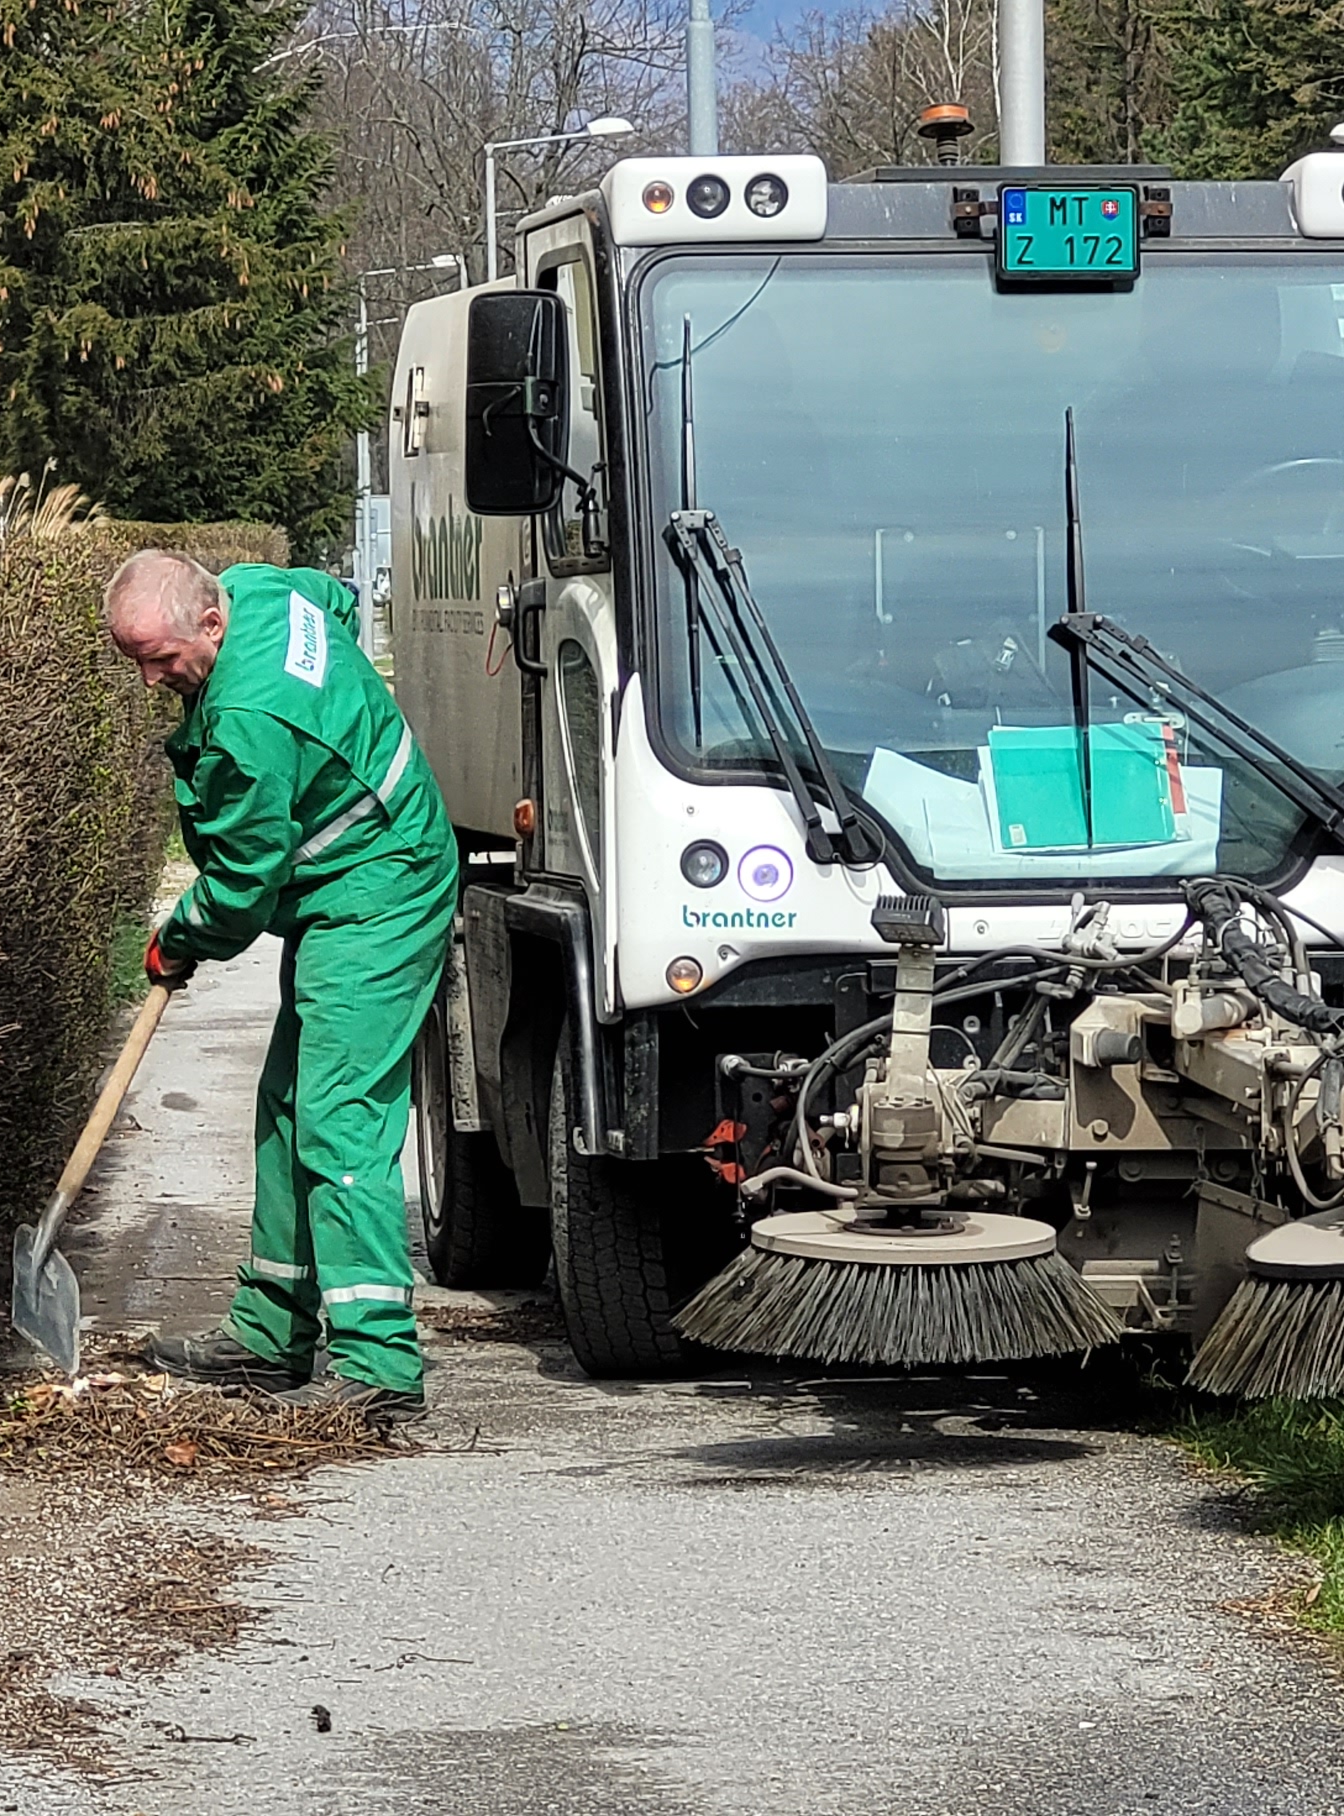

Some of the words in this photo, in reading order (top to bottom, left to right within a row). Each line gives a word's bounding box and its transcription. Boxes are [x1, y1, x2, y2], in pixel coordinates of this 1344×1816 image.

[1008, 212, 1023, 223] SK
[1049, 196, 1089, 226] MT
[1016, 235, 1034, 265] Z
[1064, 235, 1123, 265] 172
[411, 481, 482, 601] brantner
[682, 904, 798, 928] brantner
